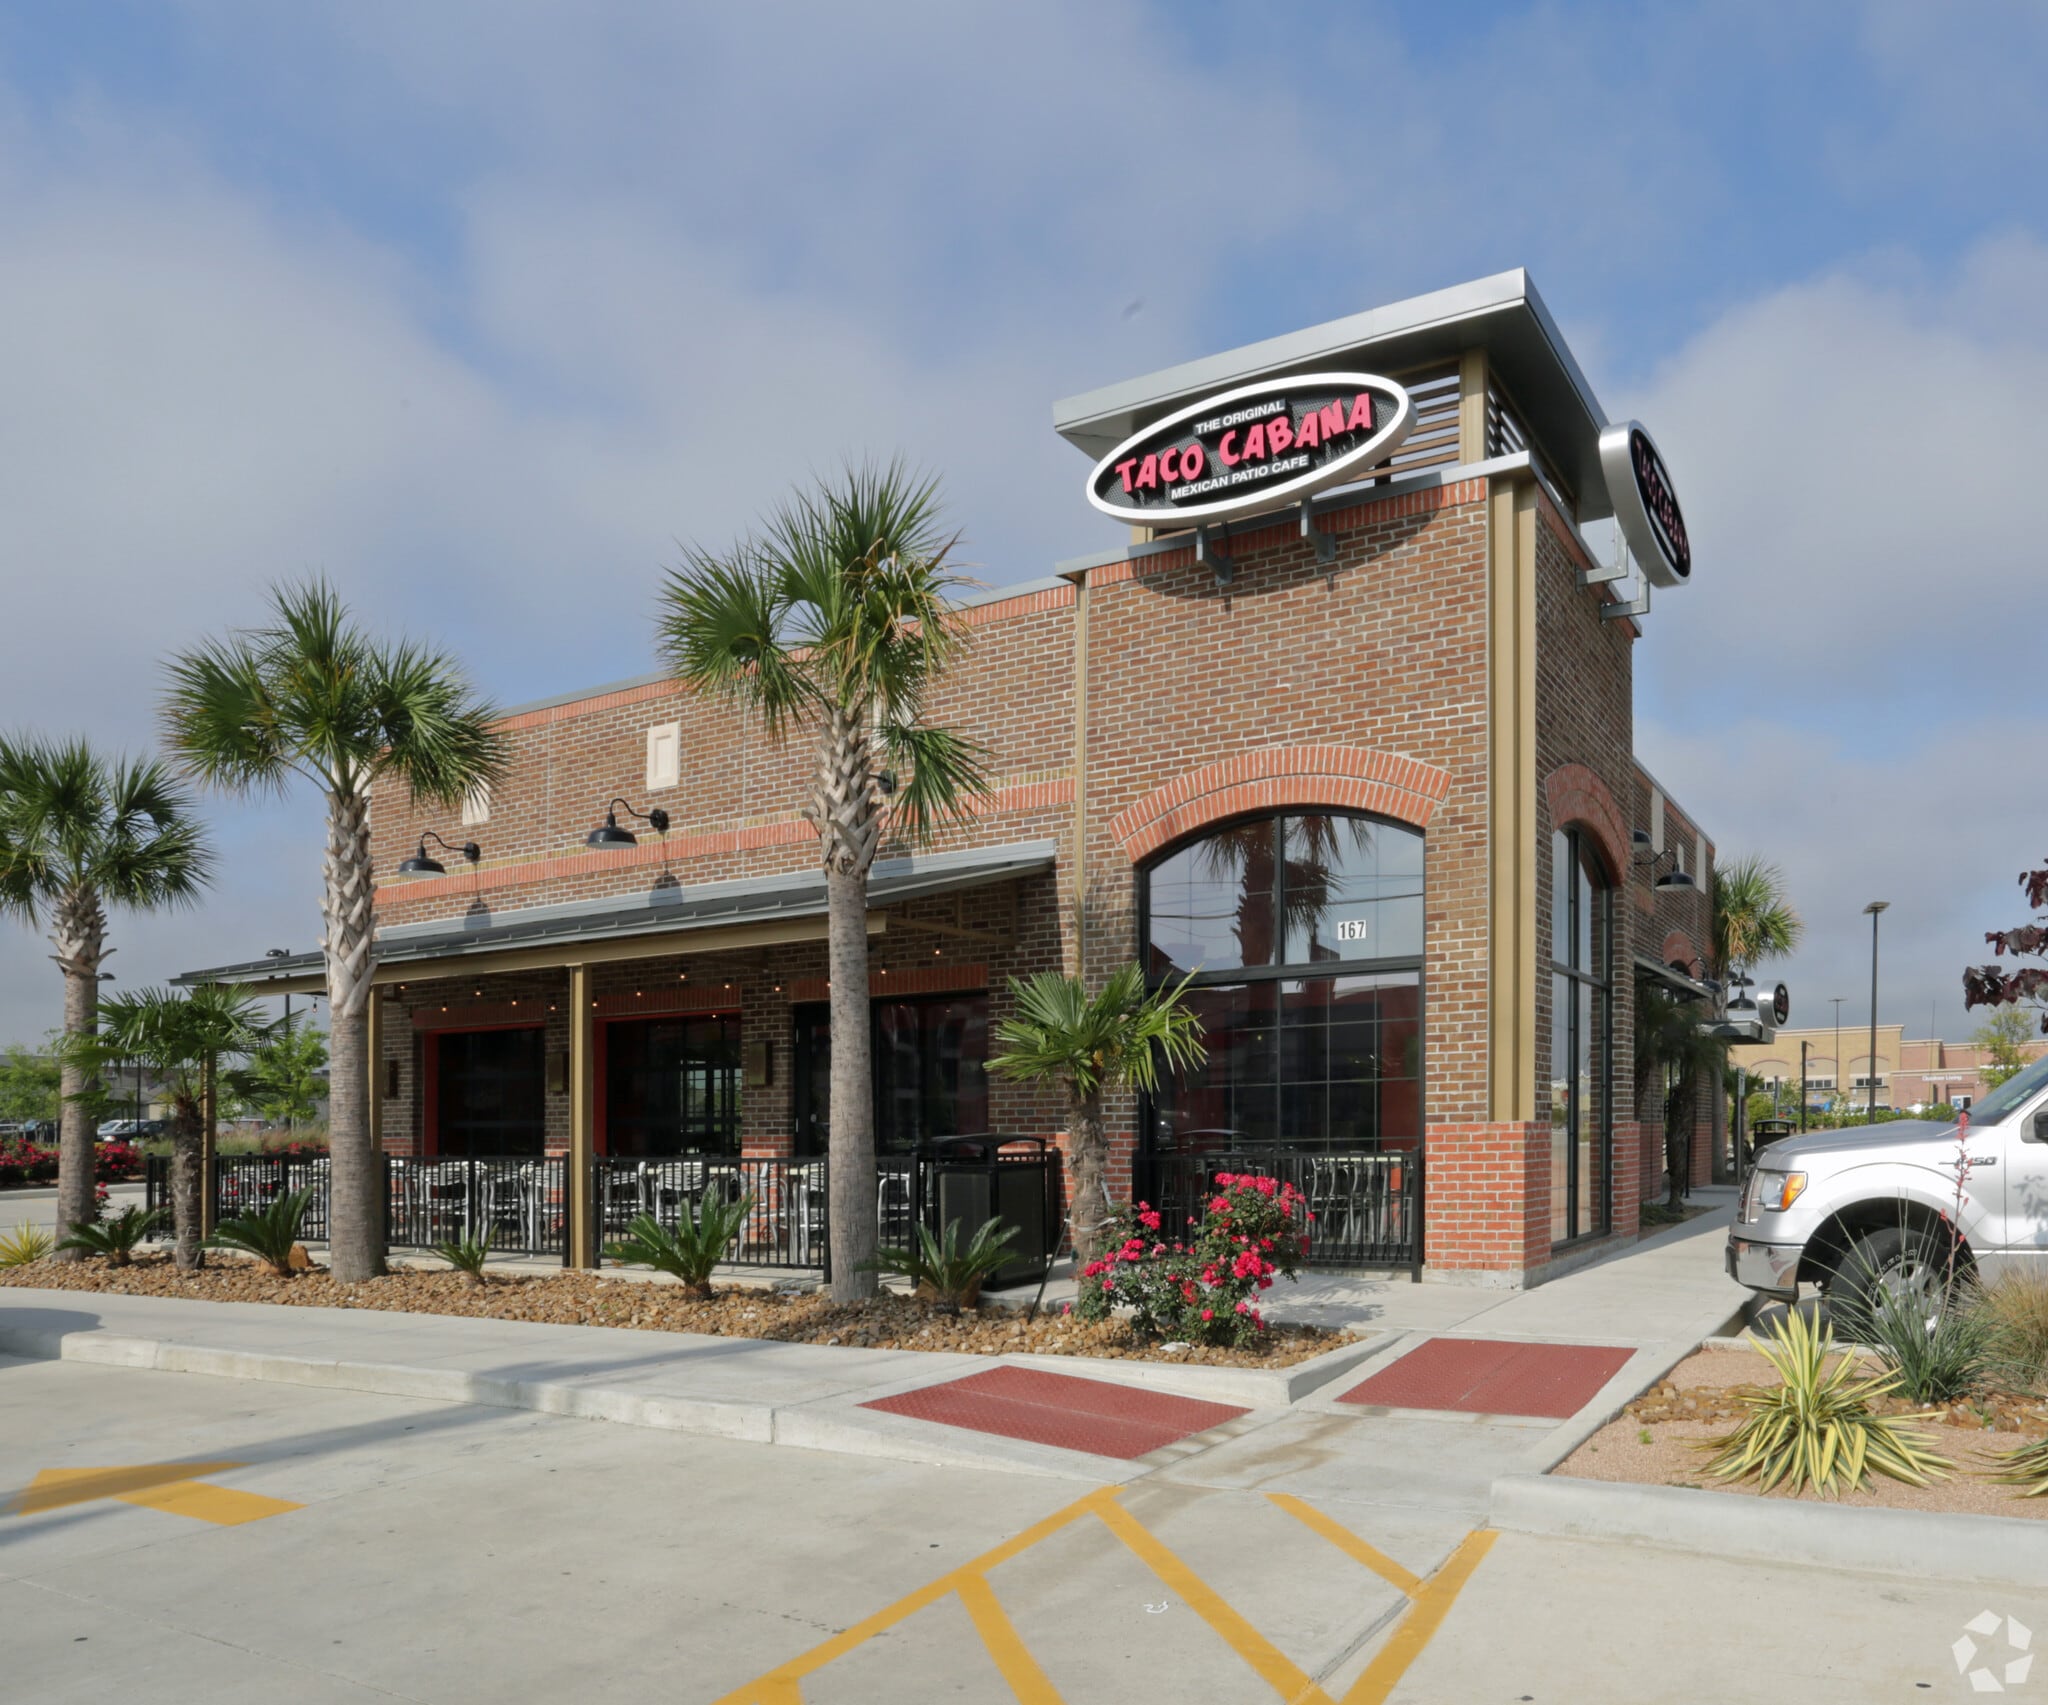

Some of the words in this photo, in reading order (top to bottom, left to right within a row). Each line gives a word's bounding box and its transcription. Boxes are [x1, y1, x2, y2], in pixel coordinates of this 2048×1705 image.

[1195, 418, 1221, 434] THE
[1222, 400, 1285, 427] ORIGINAL
[1115, 443, 1205, 493] TACO
[1219, 393, 1372, 466] CABANA
[1171, 476, 1229, 500] MEXICAN
[1231, 465, 1269, 485] PATIO
[1271, 454, 1309, 474] CAFE
[1340, 921, 1365, 939] 167
